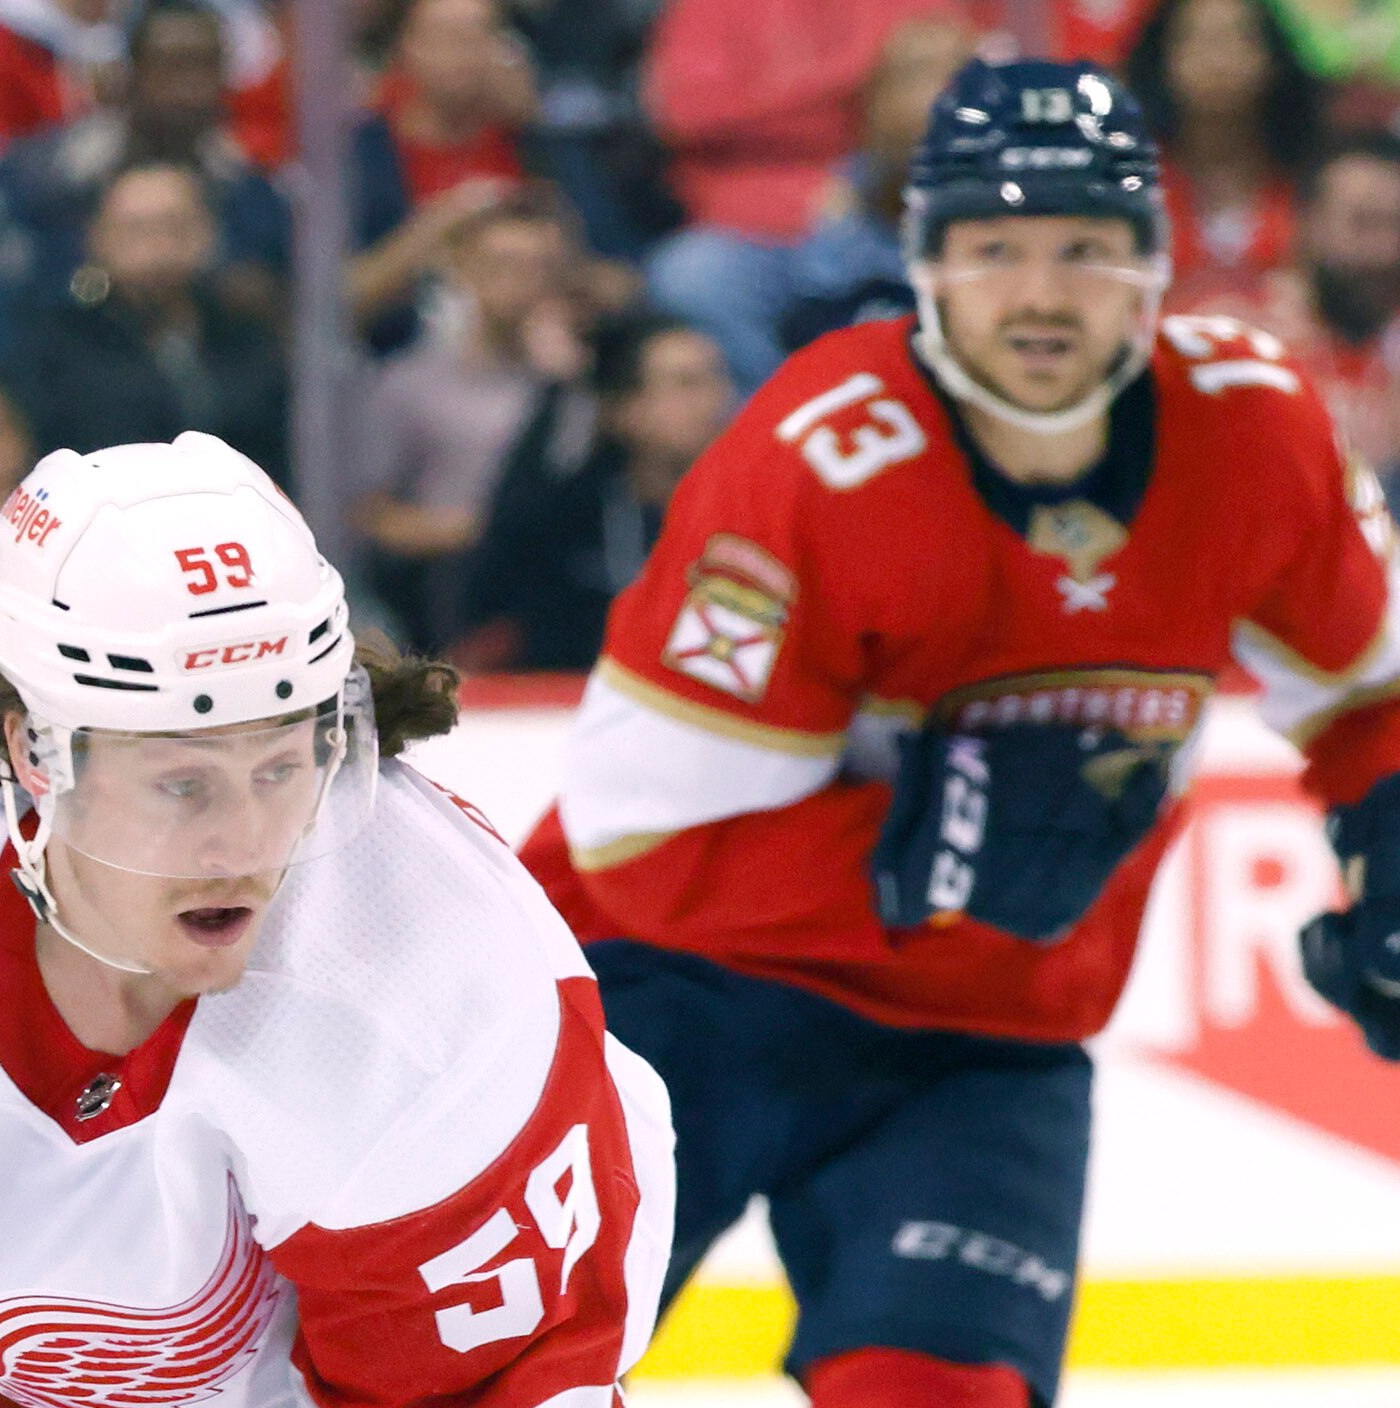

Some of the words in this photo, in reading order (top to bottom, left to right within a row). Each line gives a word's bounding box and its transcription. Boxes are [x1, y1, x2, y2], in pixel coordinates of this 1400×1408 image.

[776, 371, 927, 491] 13
[173, 541, 256, 597] 59
[183, 635, 290, 672] CCM
[416, 1122, 603, 1354] 59
